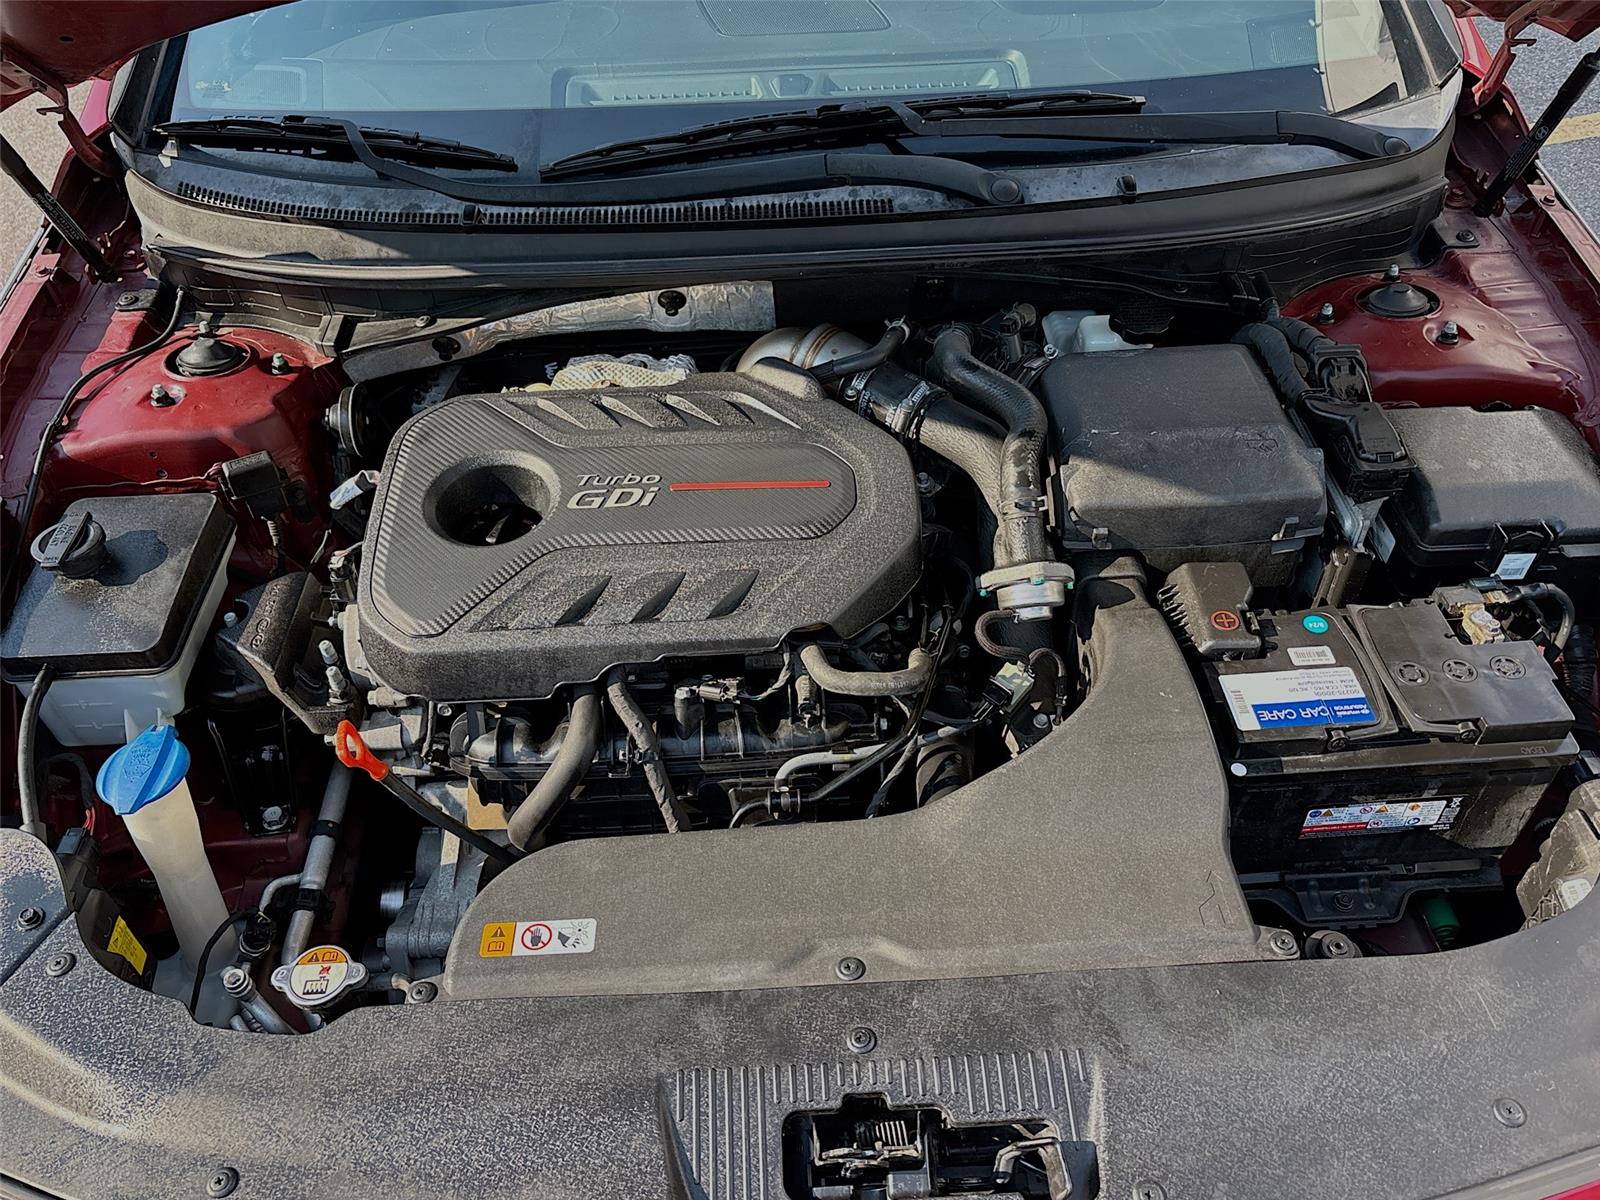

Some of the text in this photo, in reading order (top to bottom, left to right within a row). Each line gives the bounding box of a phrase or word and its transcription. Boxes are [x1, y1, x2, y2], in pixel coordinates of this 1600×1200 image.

[576, 473, 663, 487] Turbo
[567, 486, 661, 510] GDi
[1256, 705, 1329, 721] CAR CARE
